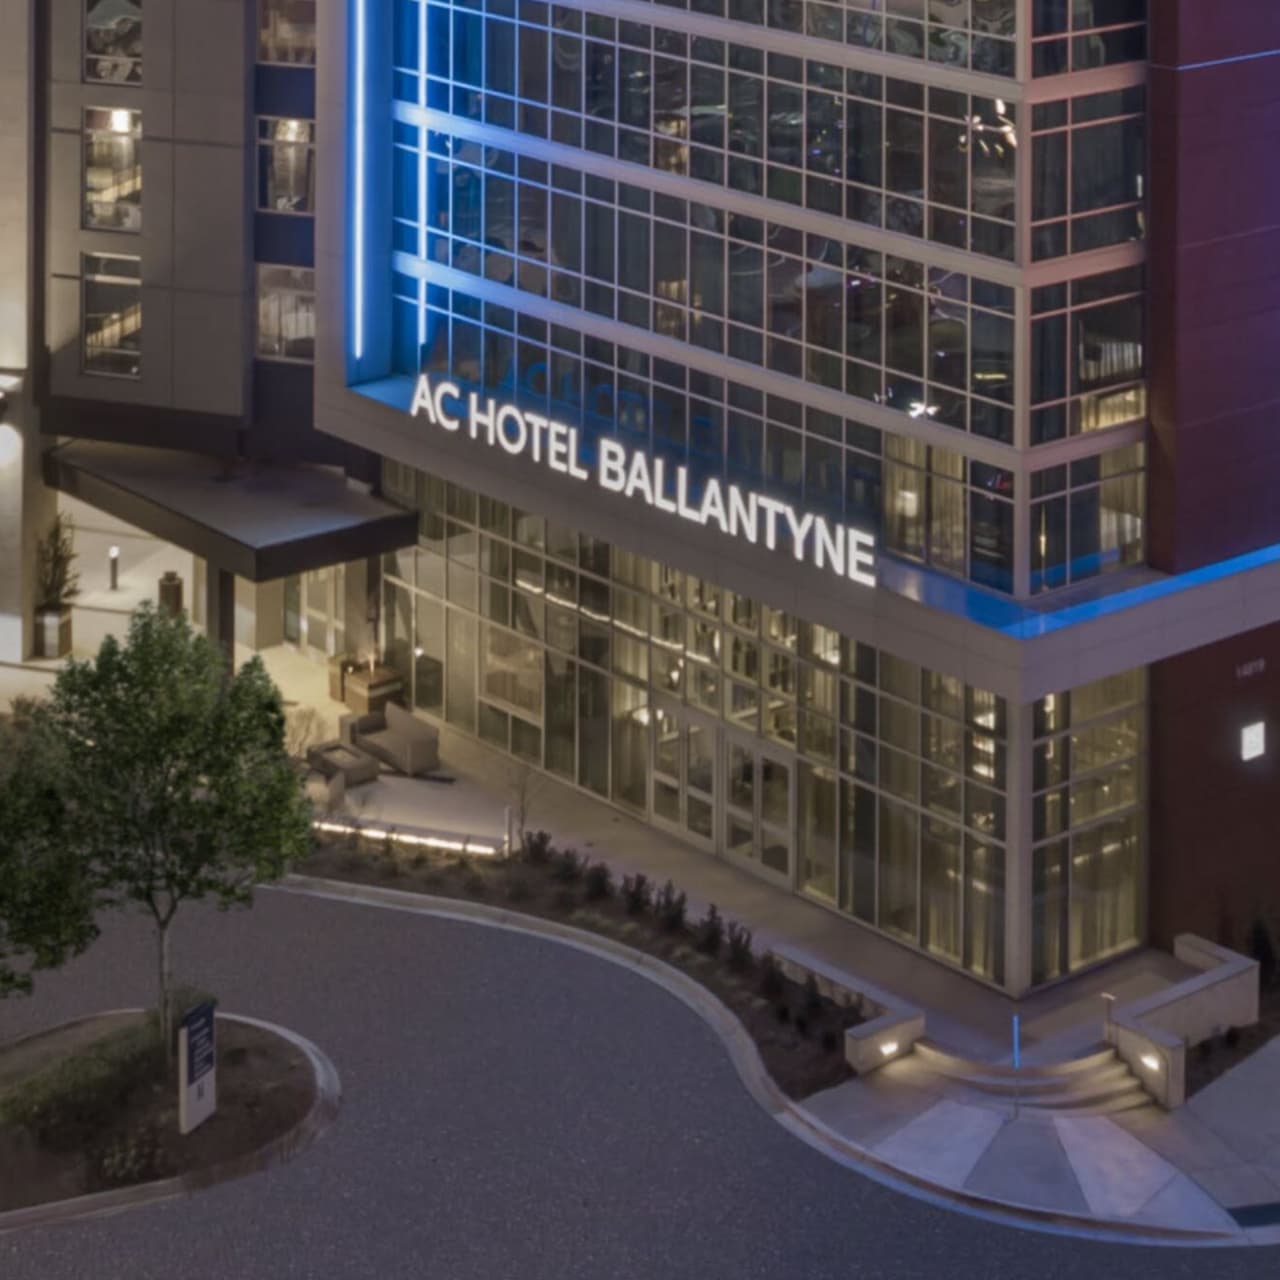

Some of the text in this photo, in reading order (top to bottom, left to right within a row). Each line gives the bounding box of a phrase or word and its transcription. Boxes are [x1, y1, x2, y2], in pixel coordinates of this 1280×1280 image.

[410, 373, 877, 588] AC HOTEL BALLANTYNE
